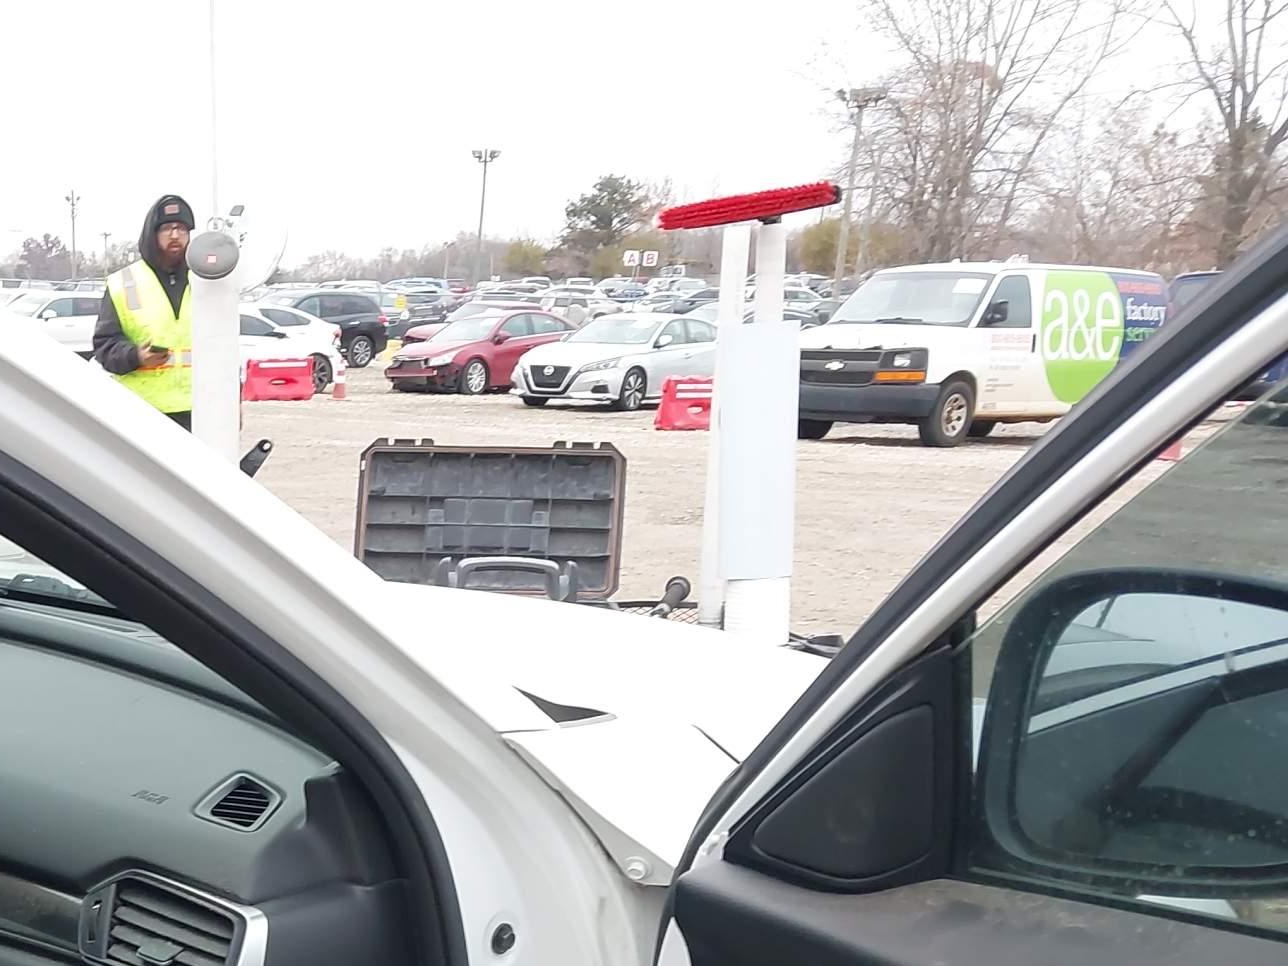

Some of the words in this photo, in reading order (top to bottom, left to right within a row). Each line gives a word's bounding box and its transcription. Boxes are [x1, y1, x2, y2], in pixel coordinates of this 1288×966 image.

[627, 253, 637, 265] A
[645, 253, 656, 265] B
[1126, 297, 1167, 327] factory
[1043, 288, 1121, 361] a&e
